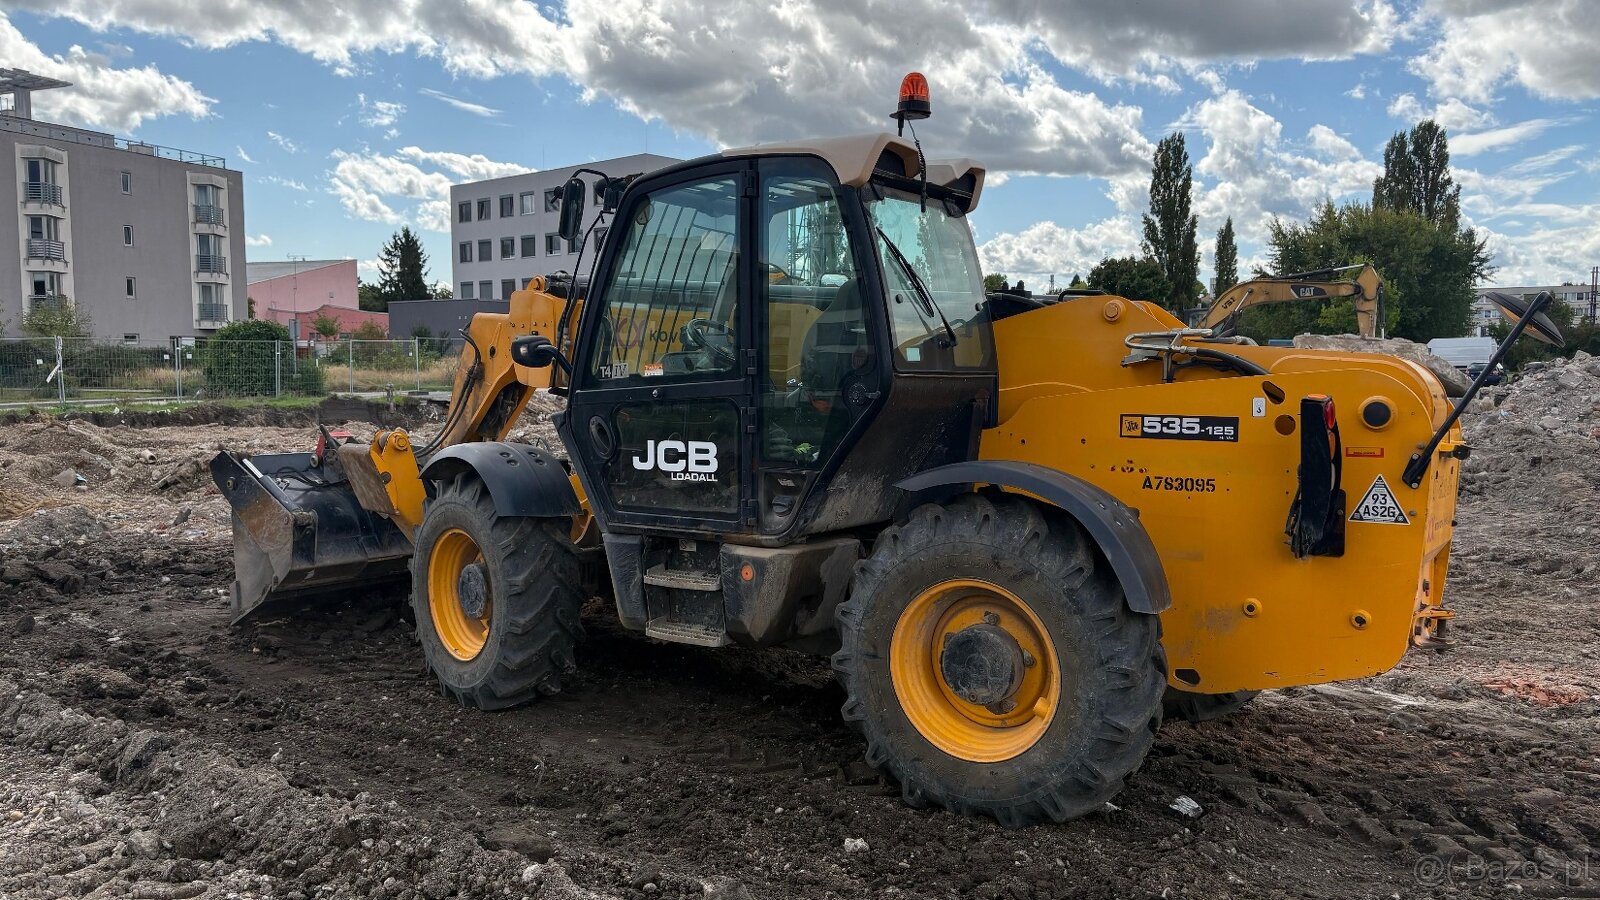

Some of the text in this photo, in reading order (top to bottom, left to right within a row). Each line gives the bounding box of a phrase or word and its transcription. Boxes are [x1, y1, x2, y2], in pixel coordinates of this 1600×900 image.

[1300, 287, 1314, 297] CAT
[1142, 416, 1234, 435] 535-125
[632, 440, 719, 473] JCB
[671, 472, 718, 482] LOADALL
[1142, 475, 1216, 492] A783095
[1371, 493, 1388, 505] 93
